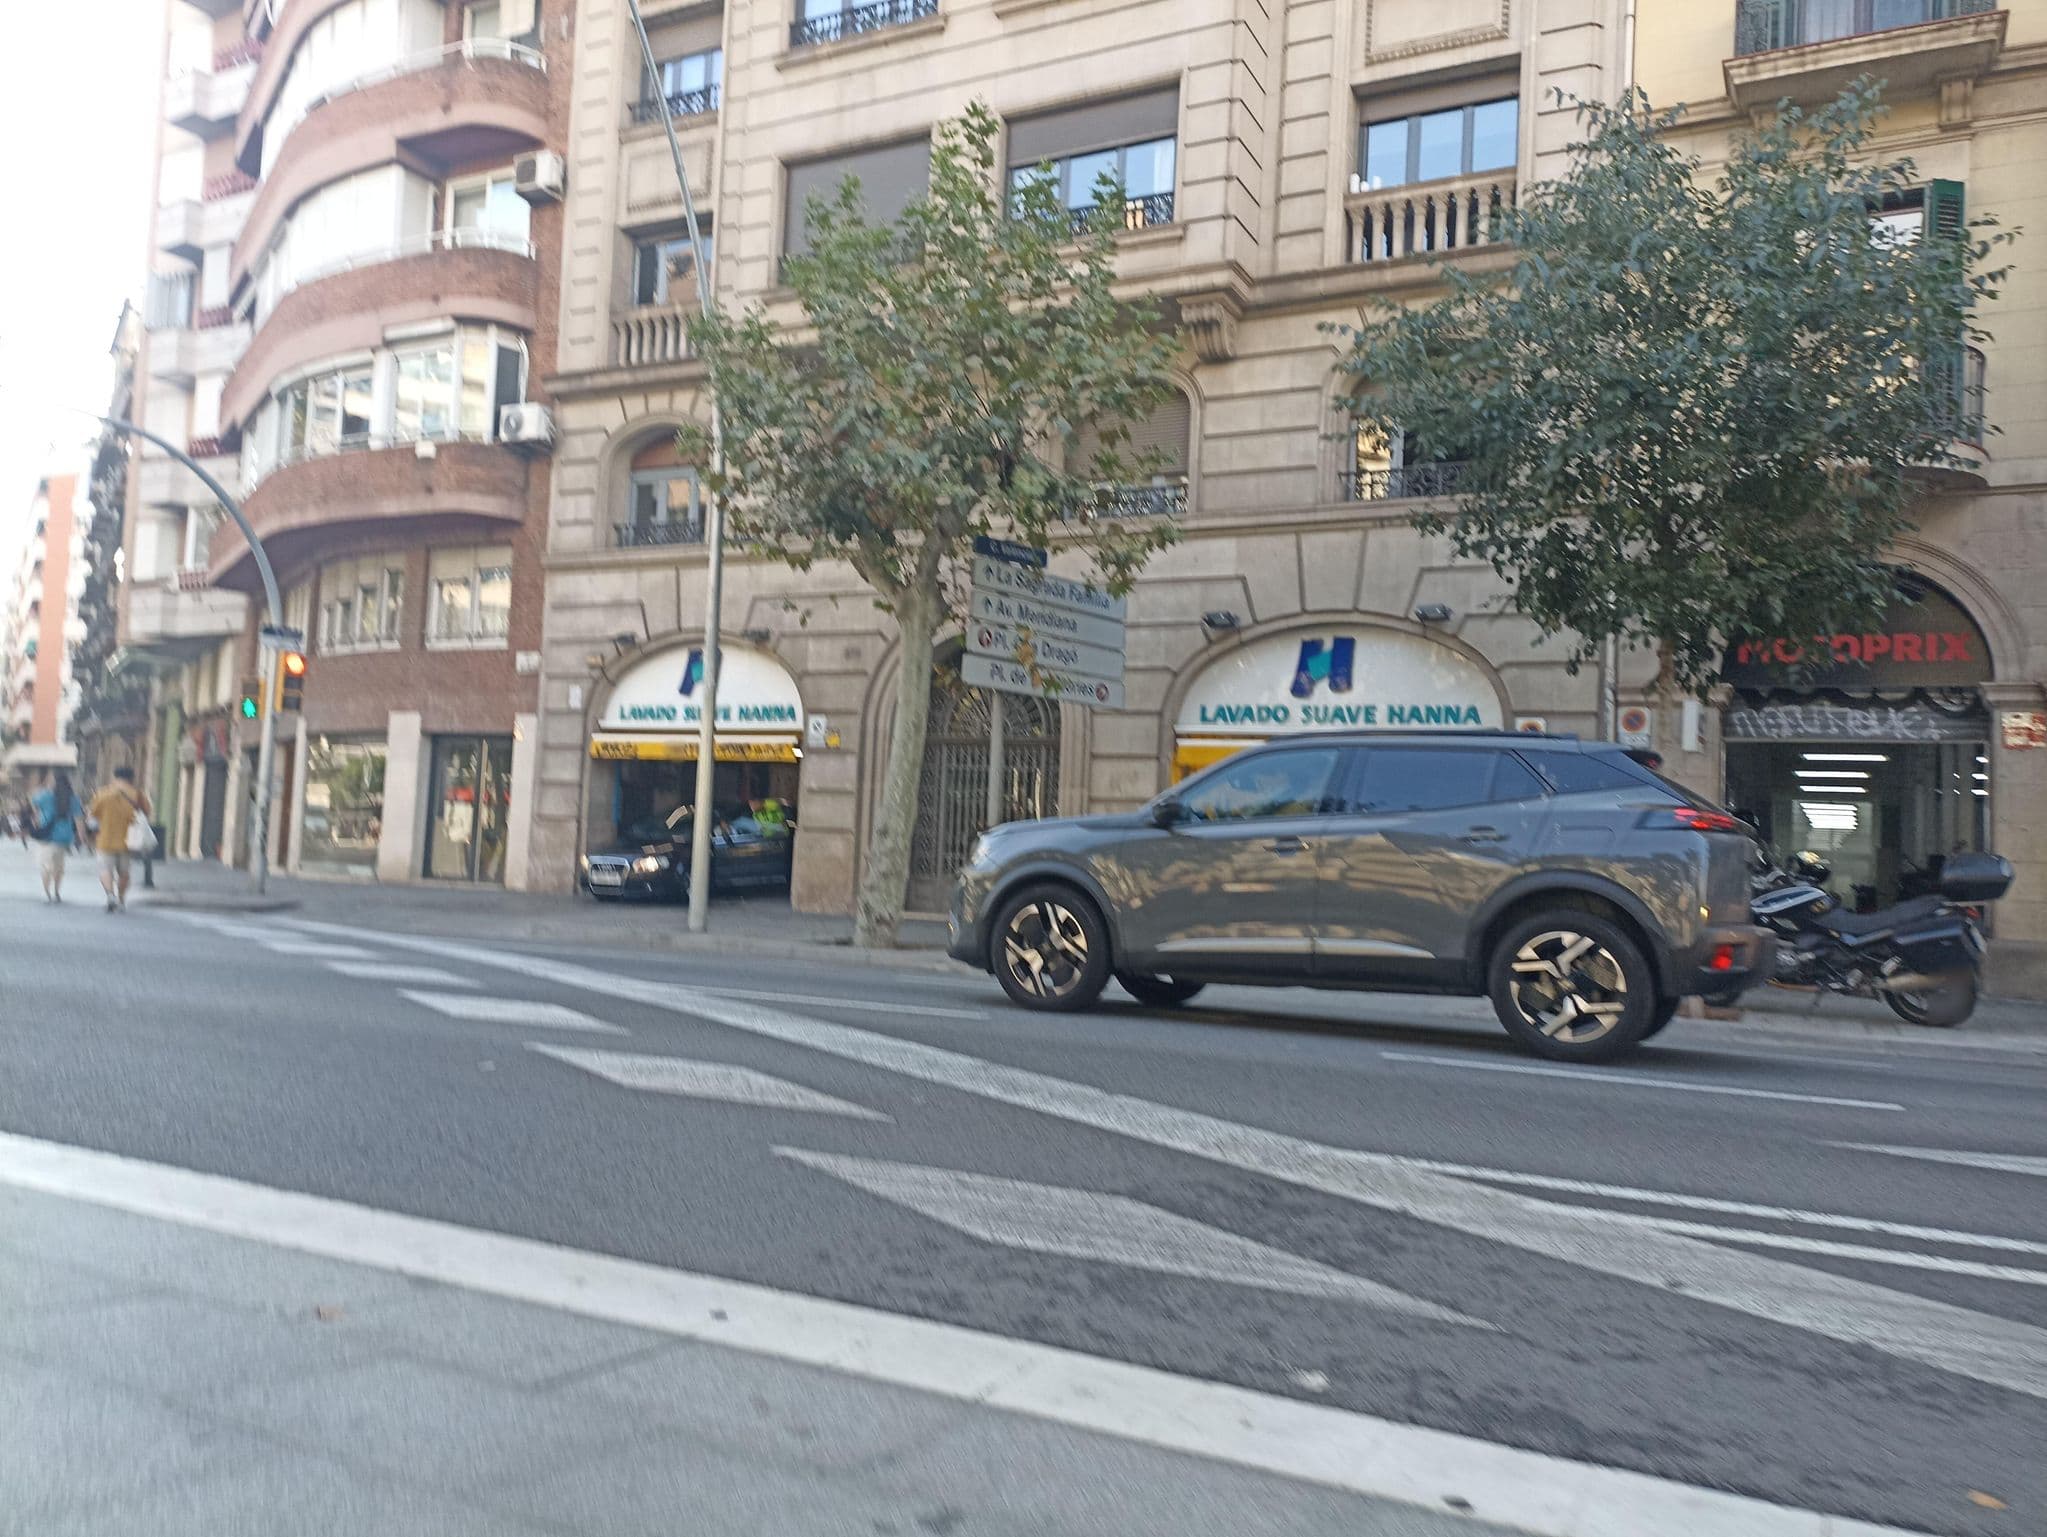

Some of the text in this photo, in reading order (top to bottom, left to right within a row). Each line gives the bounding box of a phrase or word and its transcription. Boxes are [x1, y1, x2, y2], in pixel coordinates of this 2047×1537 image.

[619, 703, 678, 721] LAVADO
[738, 703, 797, 721] HANNA
[1200, 704, 1482, 725] LAVADO SUAVE HANNA
